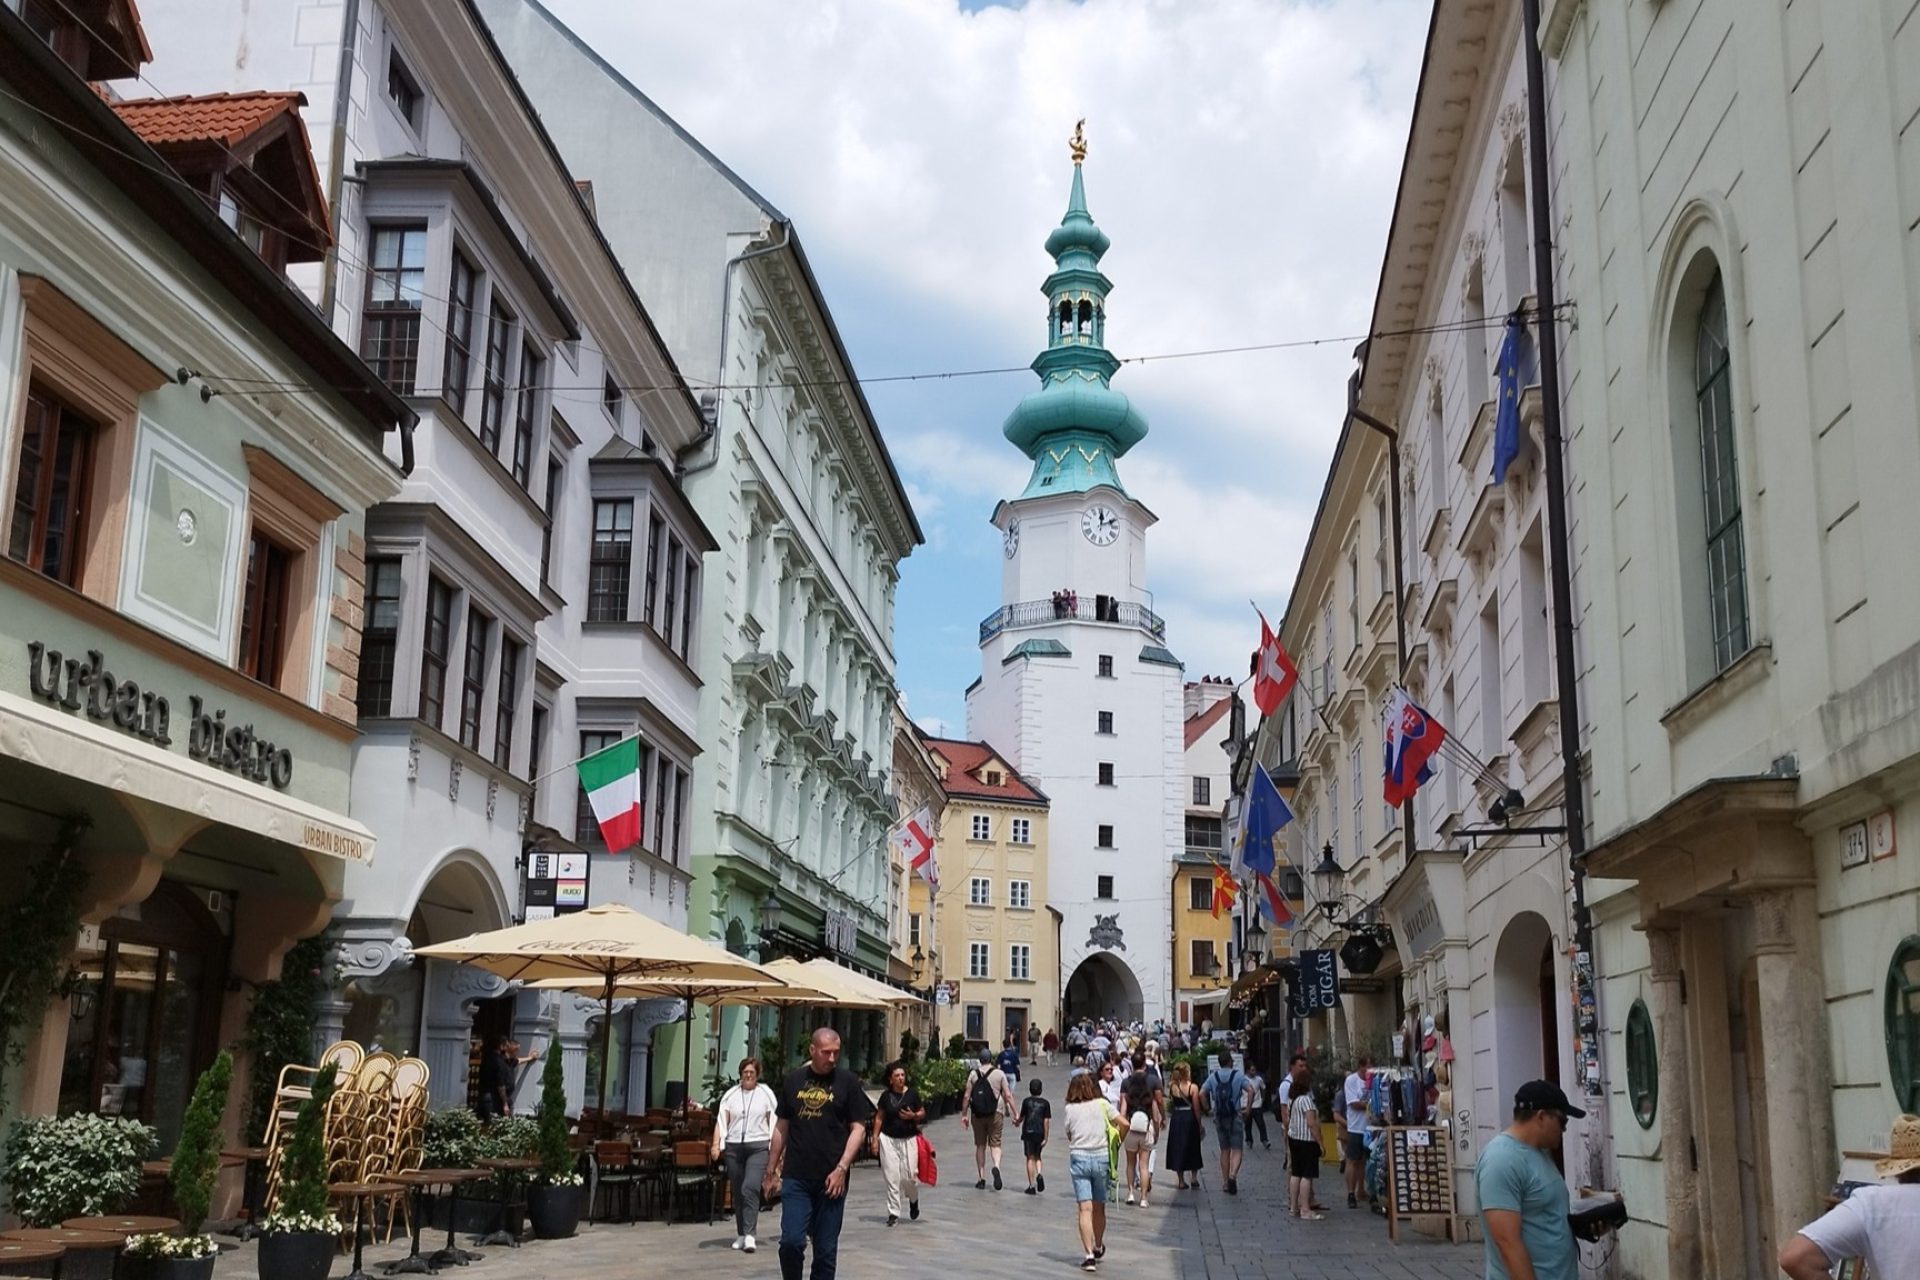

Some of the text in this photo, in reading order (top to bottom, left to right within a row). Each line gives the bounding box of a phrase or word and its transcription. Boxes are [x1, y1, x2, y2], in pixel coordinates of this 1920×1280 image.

[28, 640, 293, 789] urban bistro
[304, 824, 362, 860] URBAN BISTRO
[1308, 984, 1319, 1008] DOM
[1315, 950, 1336, 1008] CIGÁR
[797, 1090, 818, 1100] Hard
